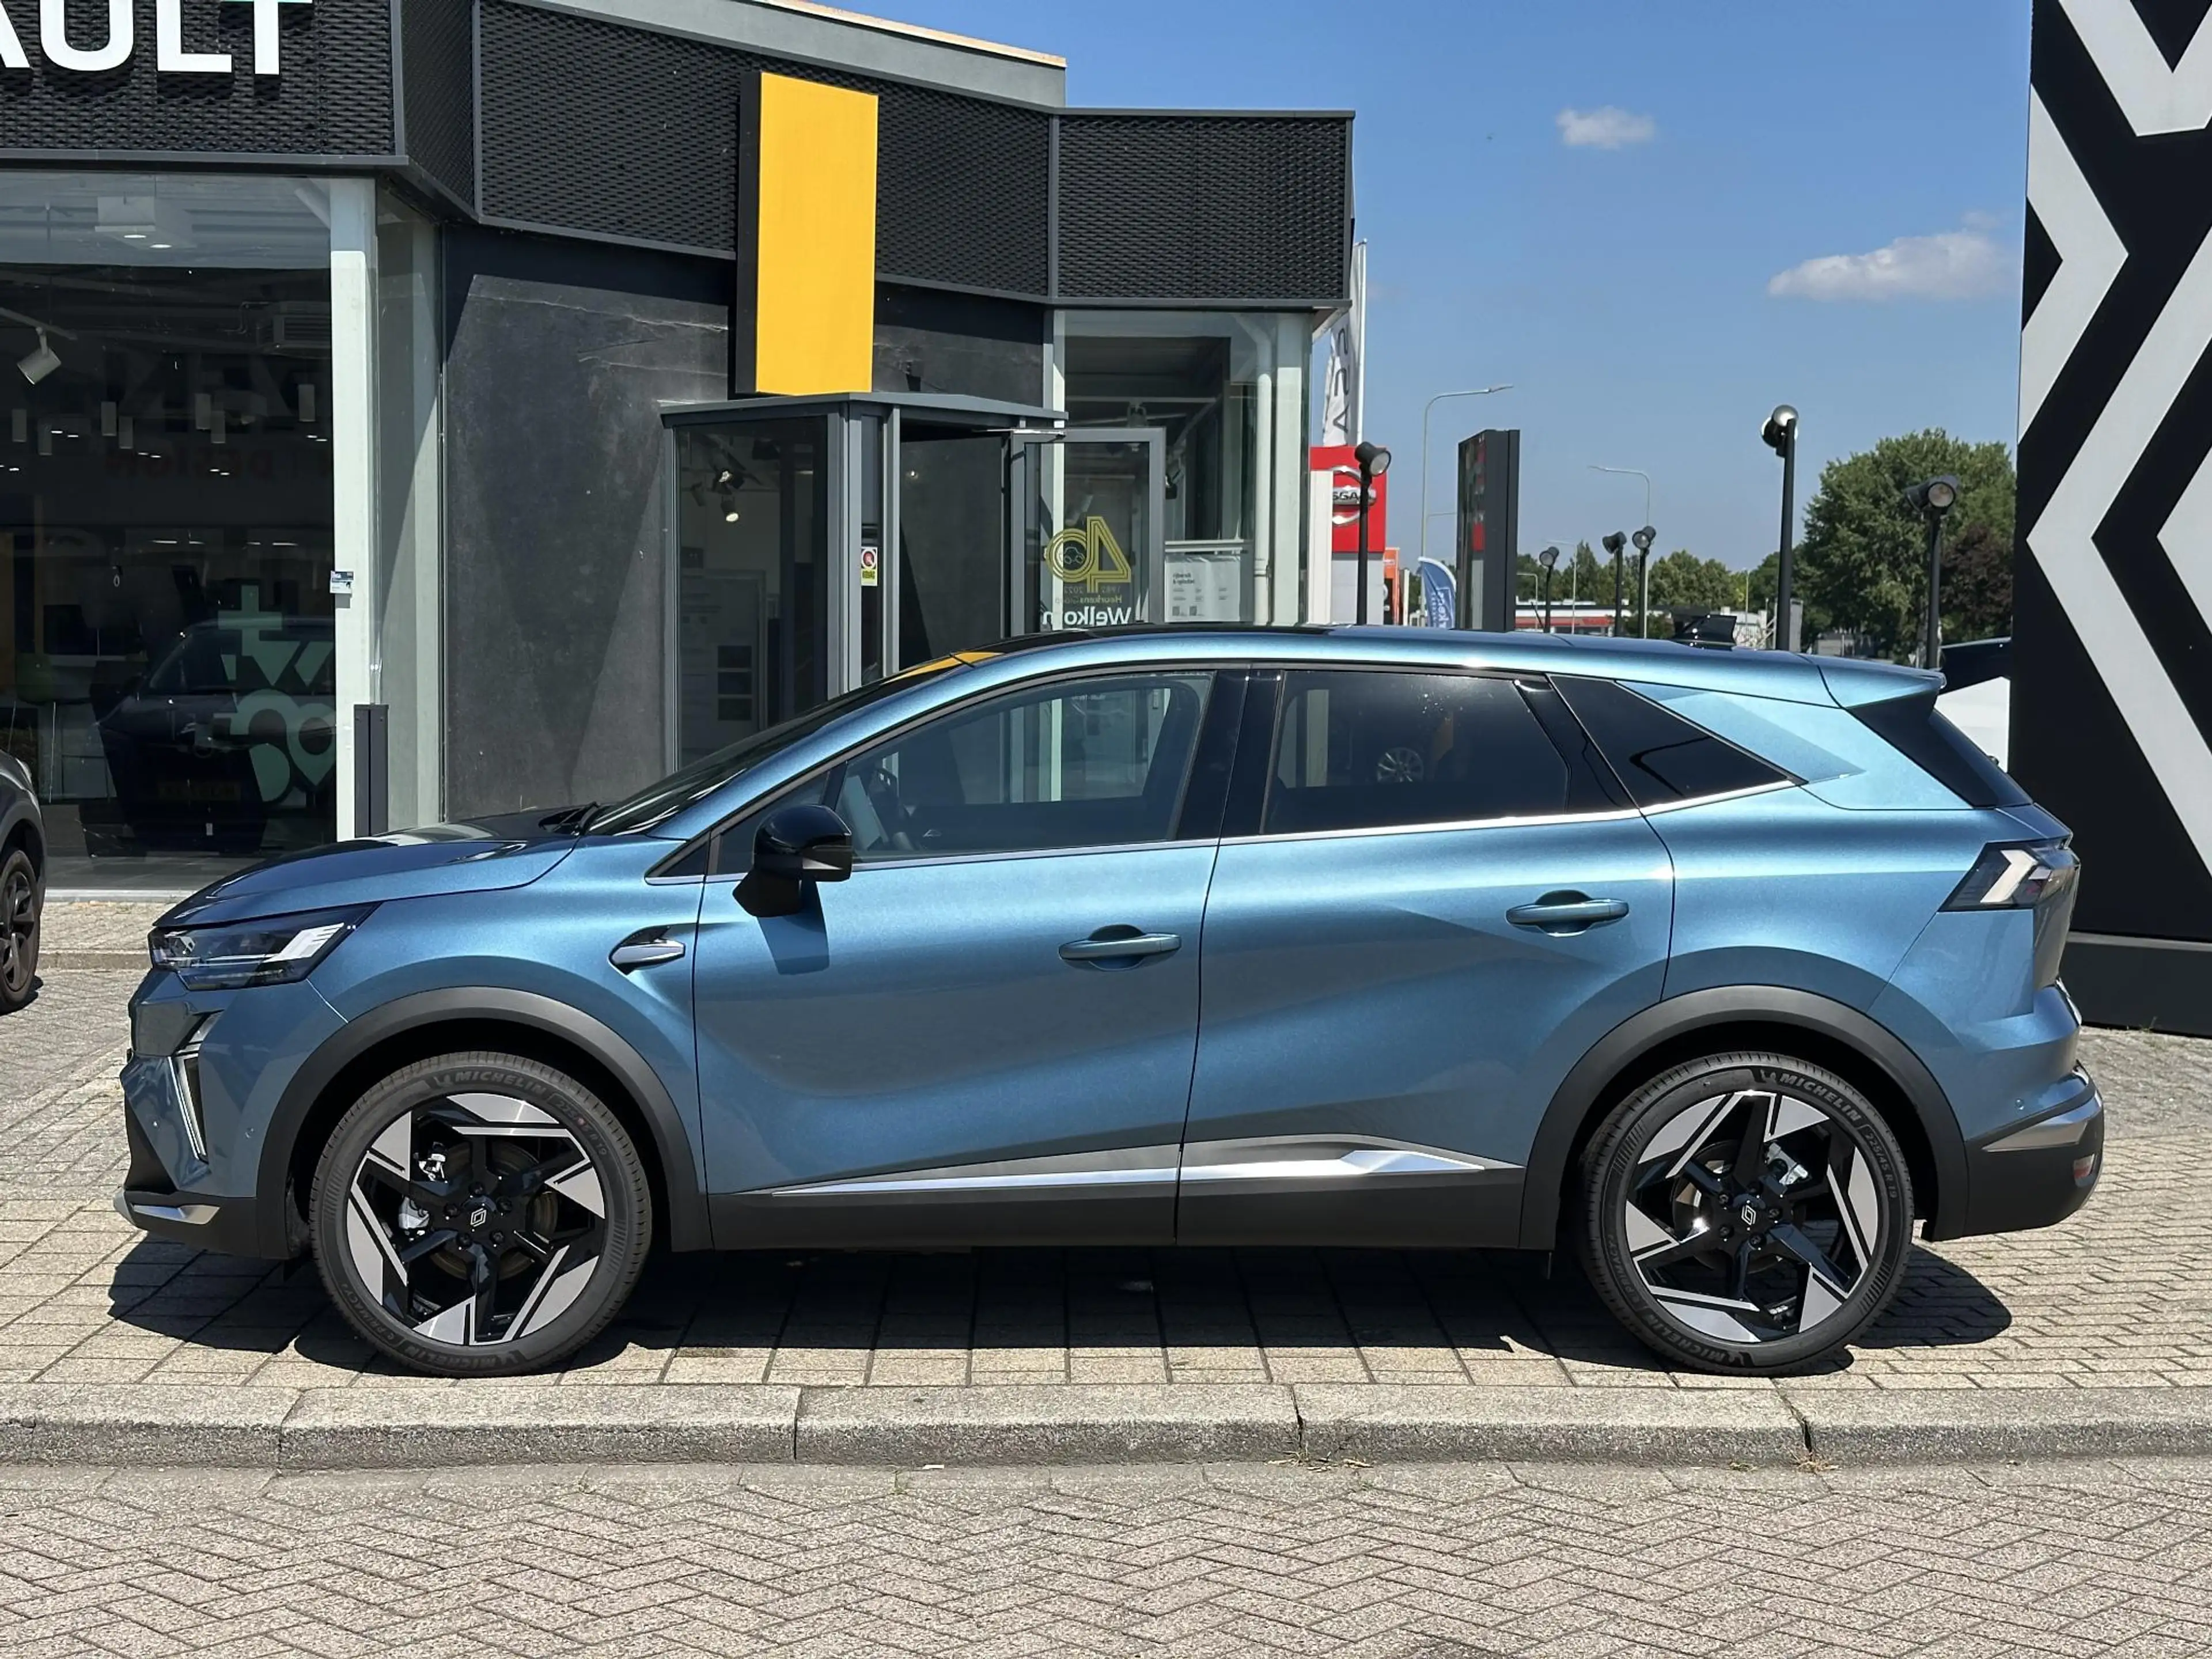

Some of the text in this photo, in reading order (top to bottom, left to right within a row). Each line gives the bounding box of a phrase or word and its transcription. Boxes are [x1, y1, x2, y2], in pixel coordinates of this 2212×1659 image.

[455, 1070, 547, 1095] MICHELIN
[1780, 1073, 1862, 1122] MICHELIN
[1642, 1313, 1726, 1362] MICHELIN
